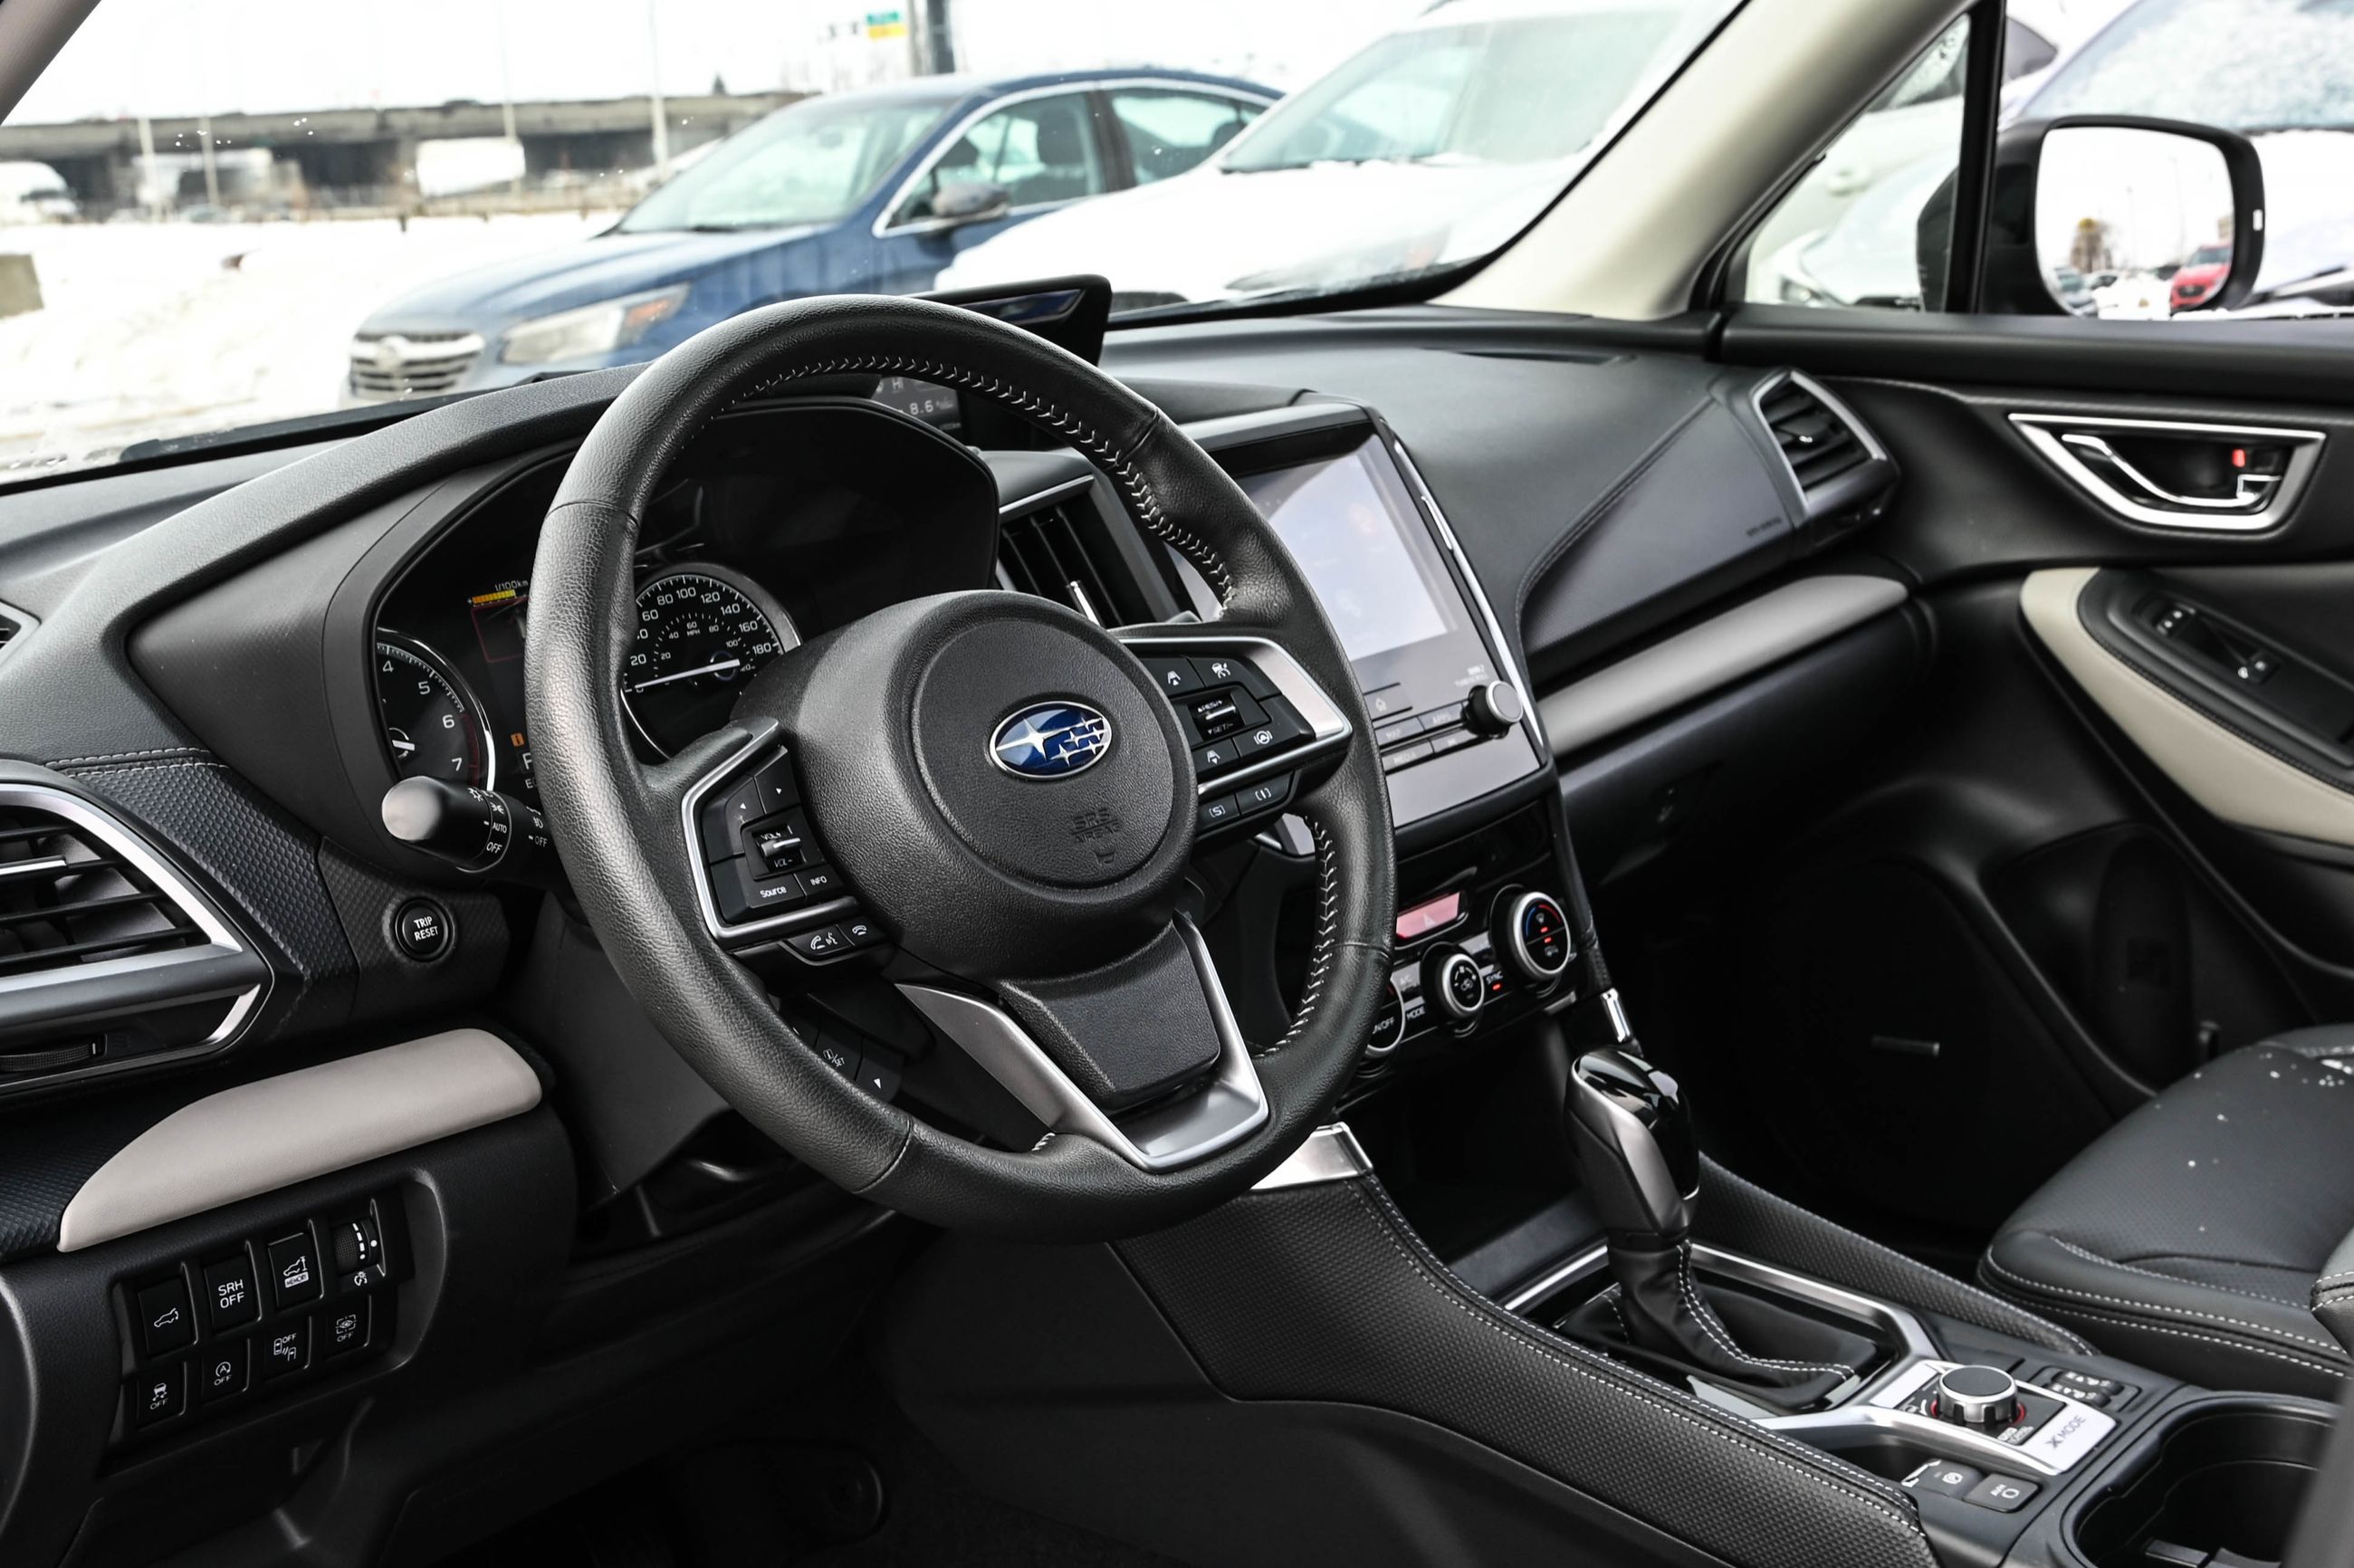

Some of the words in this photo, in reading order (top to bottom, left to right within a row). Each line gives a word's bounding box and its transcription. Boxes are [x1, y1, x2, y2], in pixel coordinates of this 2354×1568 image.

[676, 587, 696, 598] 100
[701, 591, 721, 604] 120
[656, 594, 674, 606] 80
[642, 608, 659, 621] 60
[721, 603, 741, 615] 140
[709, 625, 720, 633] 80
[739, 620, 758, 633] 160
[636, 628, 648, 640] 0
[668, 631, 679, 639] 40
[726, 639, 739, 647] 100
[752, 642, 771, 655] 180
[630, 654, 646, 666] 20
[660, 652, 671, 660] 20
[382, 660, 394, 673] 4
[418, 681, 431, 695] 5
[442, 714, 455, 729] 6
[451, 757, 463, 771] 7
[492, 821, 507, 834] AUTO
[486, 841, 502, 854] OFF
[534, 835, 548, 847] OFF
[810, 875, 828, 885] INFO
[760, 885, 787, 898] Source
[413, 915, 433, 929] TRIP
[414, 926, 438, 942] RESET
[1407, 1006, 1426, 1020] MODE
[285, 1275, 308, 1286] MEMORY
[217, 1279, 244, 1296] SRH
[220, 1292, 245, 1309] OFF
[282, 1334, 297, 1344] OFF
[336, 1332, 353, 1343] OFF
